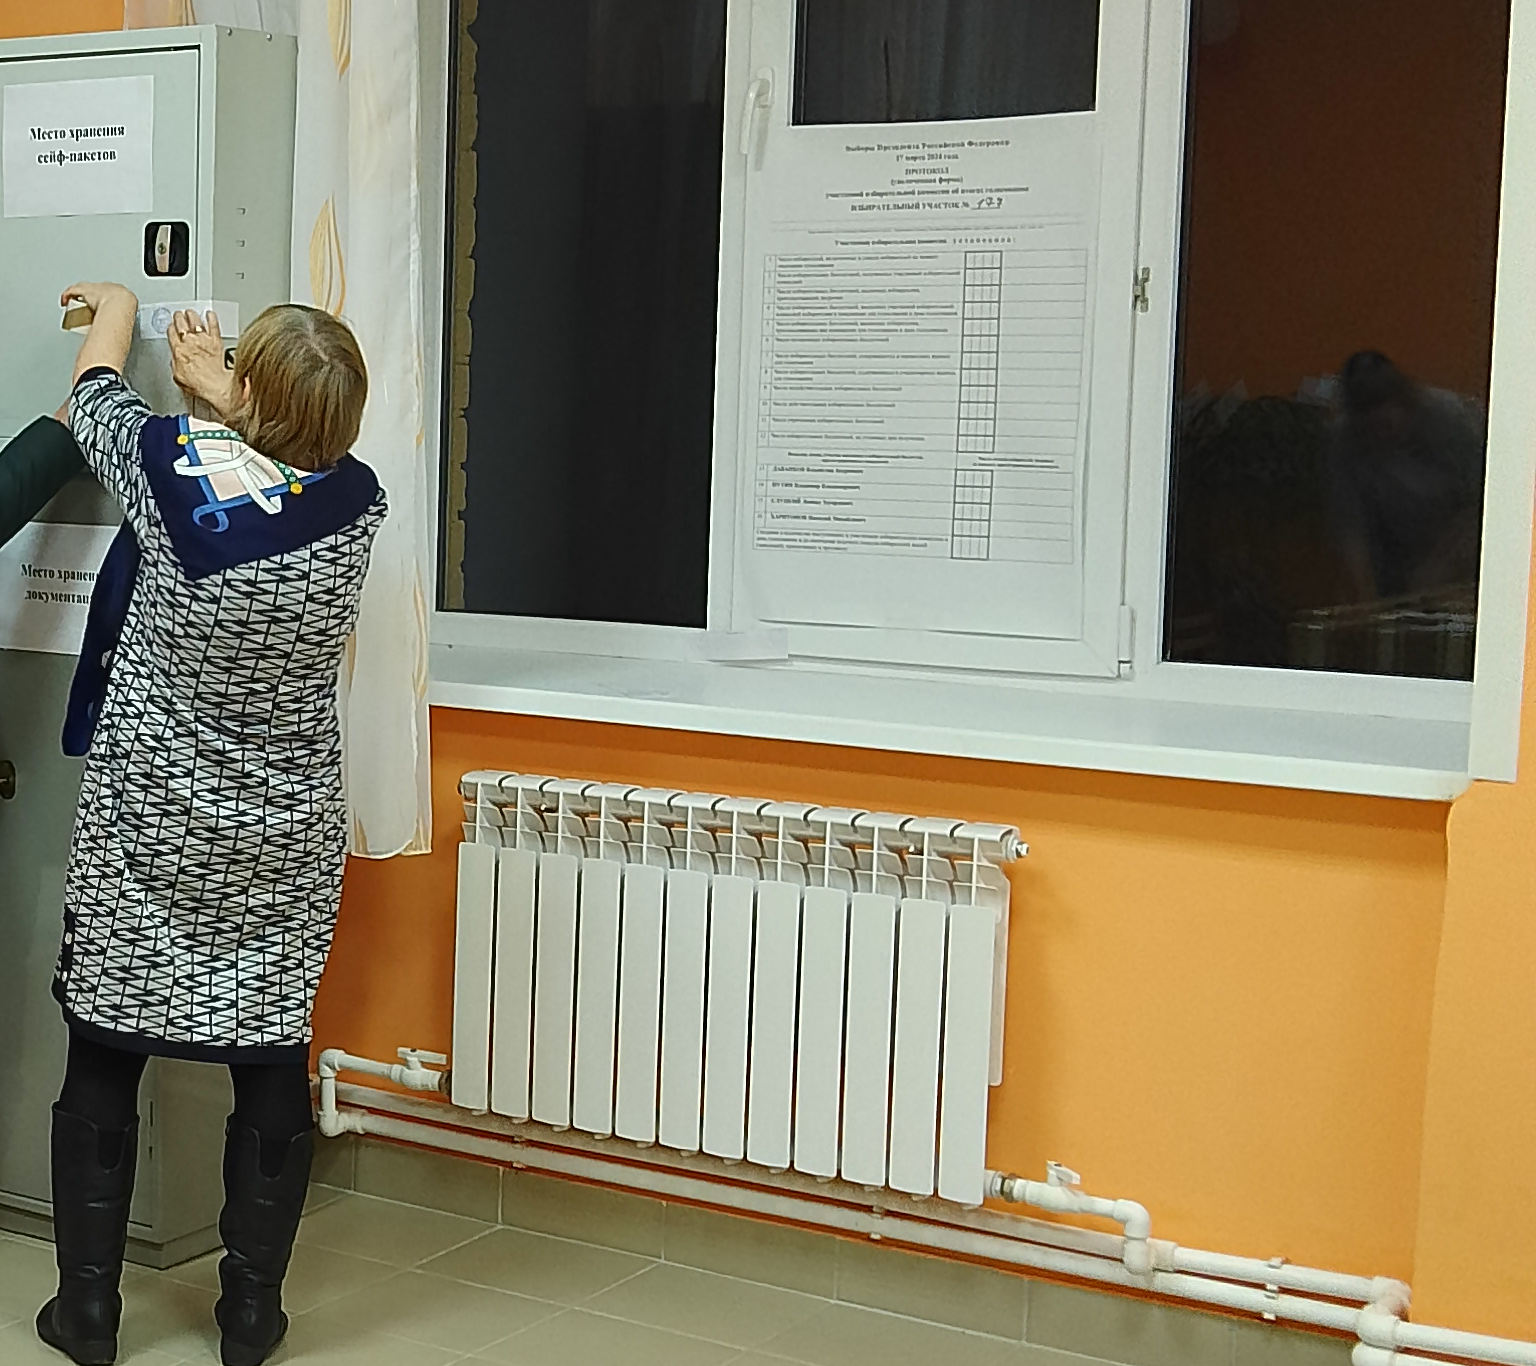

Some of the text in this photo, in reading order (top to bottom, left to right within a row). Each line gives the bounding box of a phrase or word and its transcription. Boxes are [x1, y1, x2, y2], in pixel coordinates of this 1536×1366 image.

[29, 125, 125, 142] Место хранения
[37, 150, 116, 167] сейф-пакетов
[20, 563, 95, 584] Место хранен
[24, 590, 89, 605] документац
